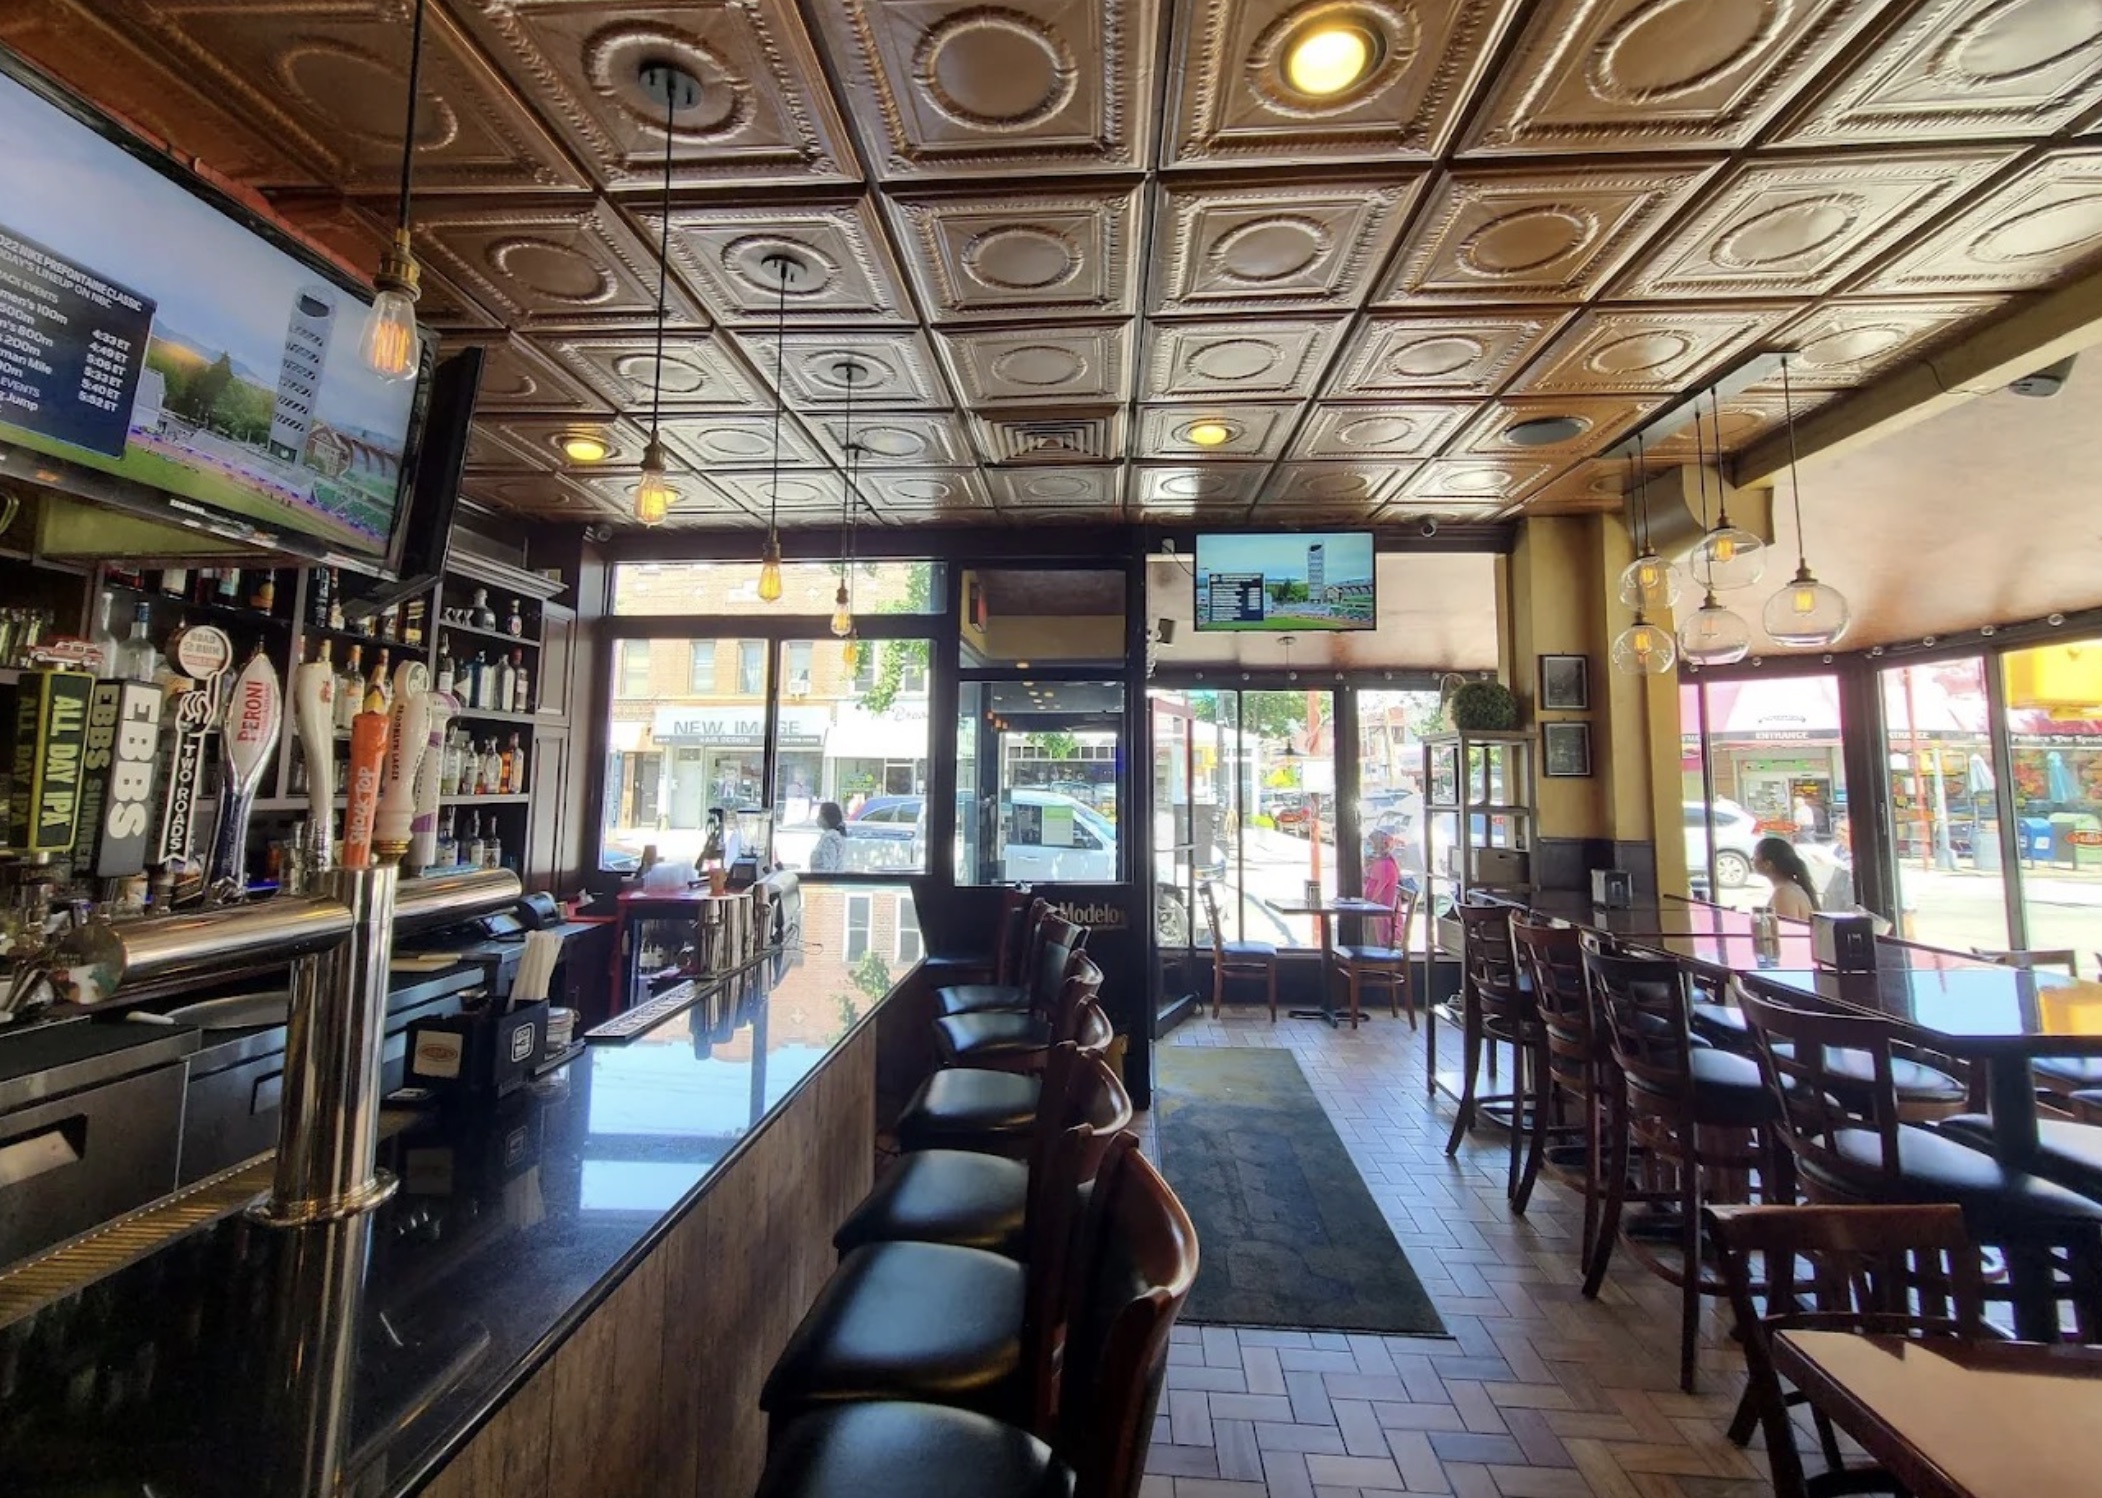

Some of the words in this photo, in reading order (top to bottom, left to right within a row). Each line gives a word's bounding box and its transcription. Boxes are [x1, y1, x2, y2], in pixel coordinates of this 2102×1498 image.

[19, 244, 44, 265] NIKE
[44, 256, 107, 295] PREFONTAINE
[106, 287, 142, 312] CLASSIC
[23, 281, 59, 303] EVENTS
[36, 266, 74, 288] LINEUP
[75, 284, 90, 298] ON
[92, 292, 112, 309] NBC
[37, 303, 68, 325] 100m
[117, 339, 131, 351] ET
[4, 334, 41, 356] 200m
[109, 376, 124, 388] ET
[18, 325, 53, 347] 800m
[112, 364, 127, 376] ET
[114, 351, 129, 364] ET
[1, 376, 40, 397] EVENTS
[28, 357, 53, 374] Mile
[107, 387, 121, 400] ET
[6, 392, 39, 411] Jump
[104, 400, 118, 412] ET
[18, 696, 38, 736] ALL
[50, 695, 83, 737] ALL
[85, 684, 121, 771] EBBS
[236, 680, 264, 742] PERONI
[734, 720, 800, 735] IMGE
[1755, 731, 1809, 740] ENTRANCE
[13, 744, 34, 785] DAY
[46, 743, 79, 784] DAY
[107, 684, 163, 839] EBBS
[178, 743, 197, 782] TWO
[41, 791, 75, 827] IPA
[168, 787, 190, 851] ROADS
[1060, 901, 1119, 924] Modelo
